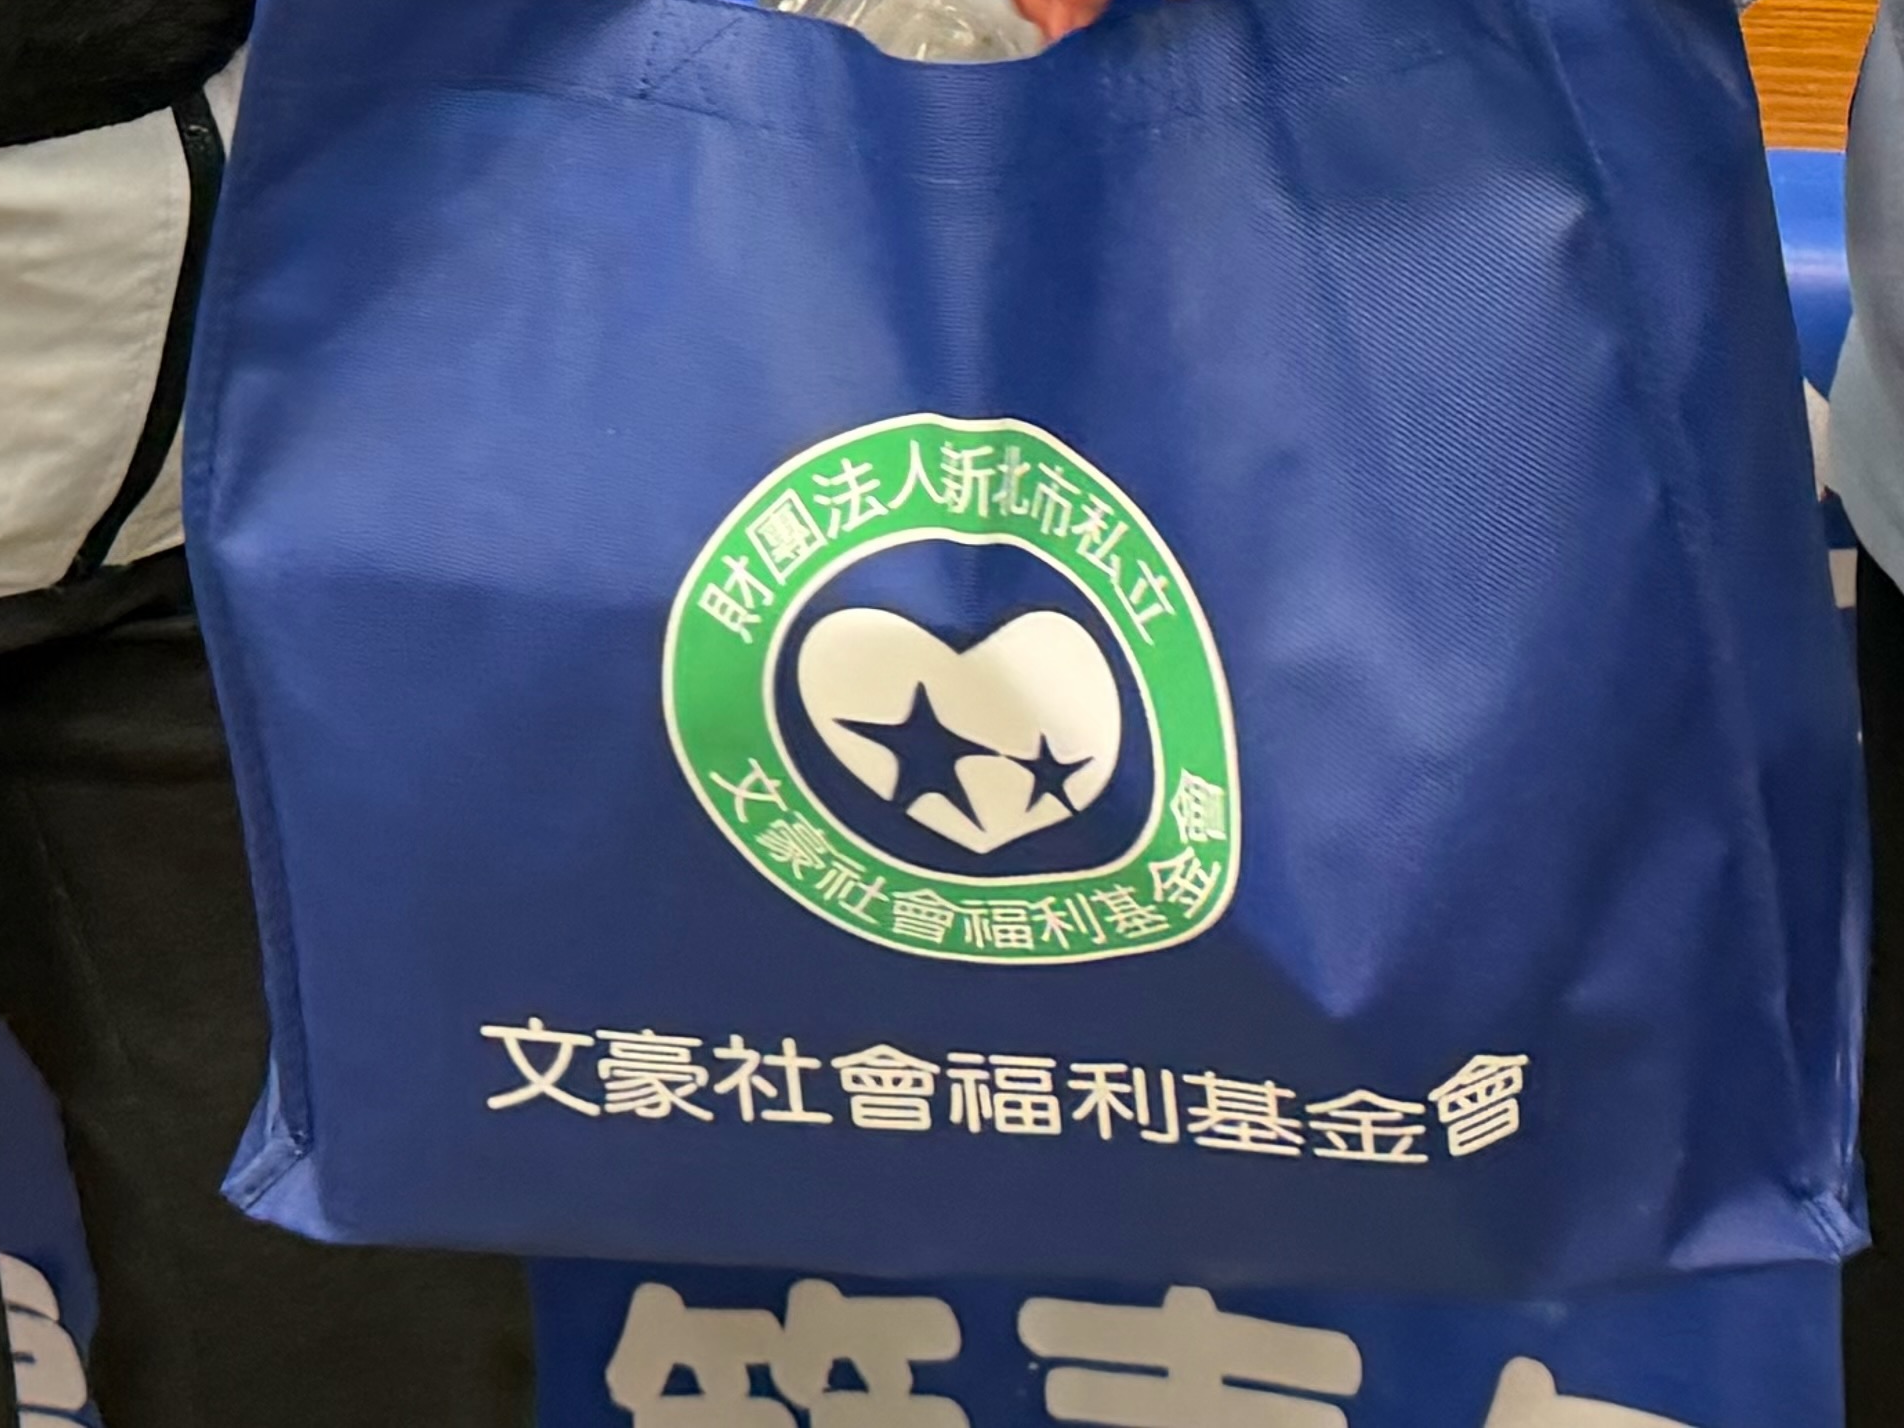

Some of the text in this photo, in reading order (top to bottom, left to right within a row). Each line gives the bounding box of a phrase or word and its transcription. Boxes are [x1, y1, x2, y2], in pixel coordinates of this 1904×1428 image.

[696, 438, 1176, 648] 財團法人新北市私立
[708, 757, 1227, 952] 文豪社會福利基金會
[480, 1016, 1530, 1164] 文豪社會福利基金會
